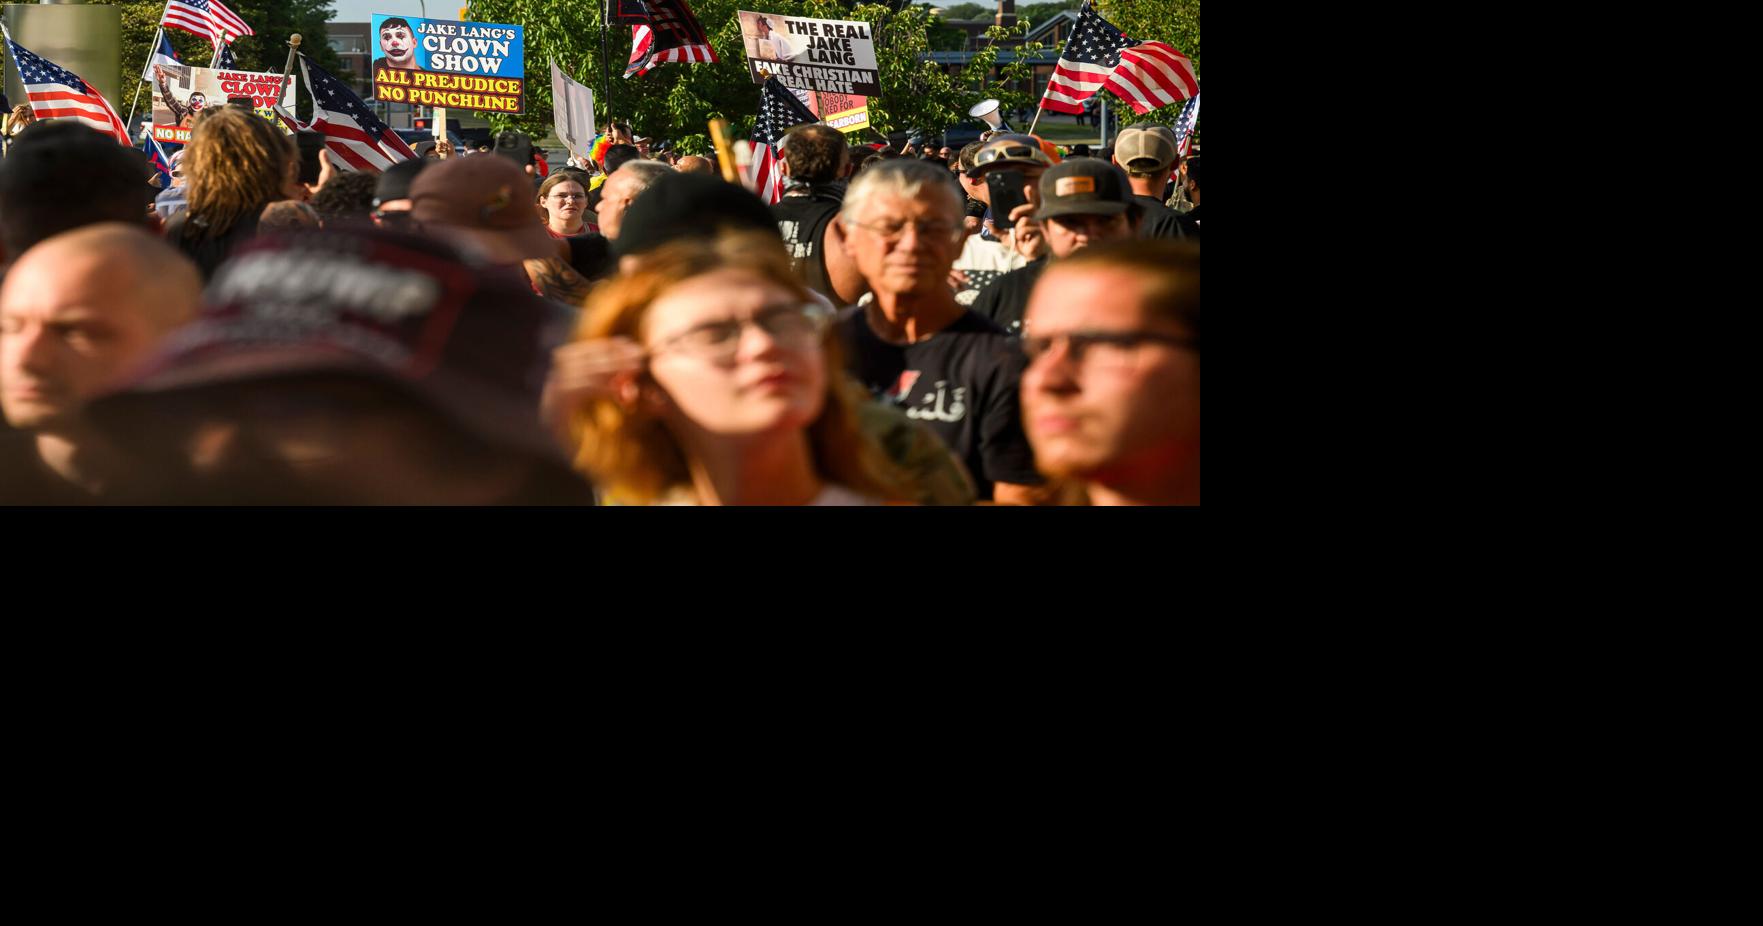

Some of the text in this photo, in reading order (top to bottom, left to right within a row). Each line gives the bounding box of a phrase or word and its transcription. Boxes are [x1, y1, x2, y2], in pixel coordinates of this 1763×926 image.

[418, 23, 515, 40] JAKE LANG'S
[785, 21, 869, 39] THE REAL
[423, 36, 510, 57] CLOWN
[807, 36, 852, 52] JAKE
[431, 54, 502, 74] SHOW
[808, 50, 855, 65] LANG
[217, 72, 248, 82] JAKE
[754, 61, 873, 84] FAKE CHRISTIAN
[377, 70, 520, 94] ALL PREJUDICE
[777, 75, 854, 94] REAL HATE
[379, 86, 518, 110] NO PUNCHLINE
[825, 94, 848, 106] OBODY
[840, 100, 854, 112] FOR
[827, 113, 866, 128] EARBORN
[156, 129, 192, 140] NO HA
